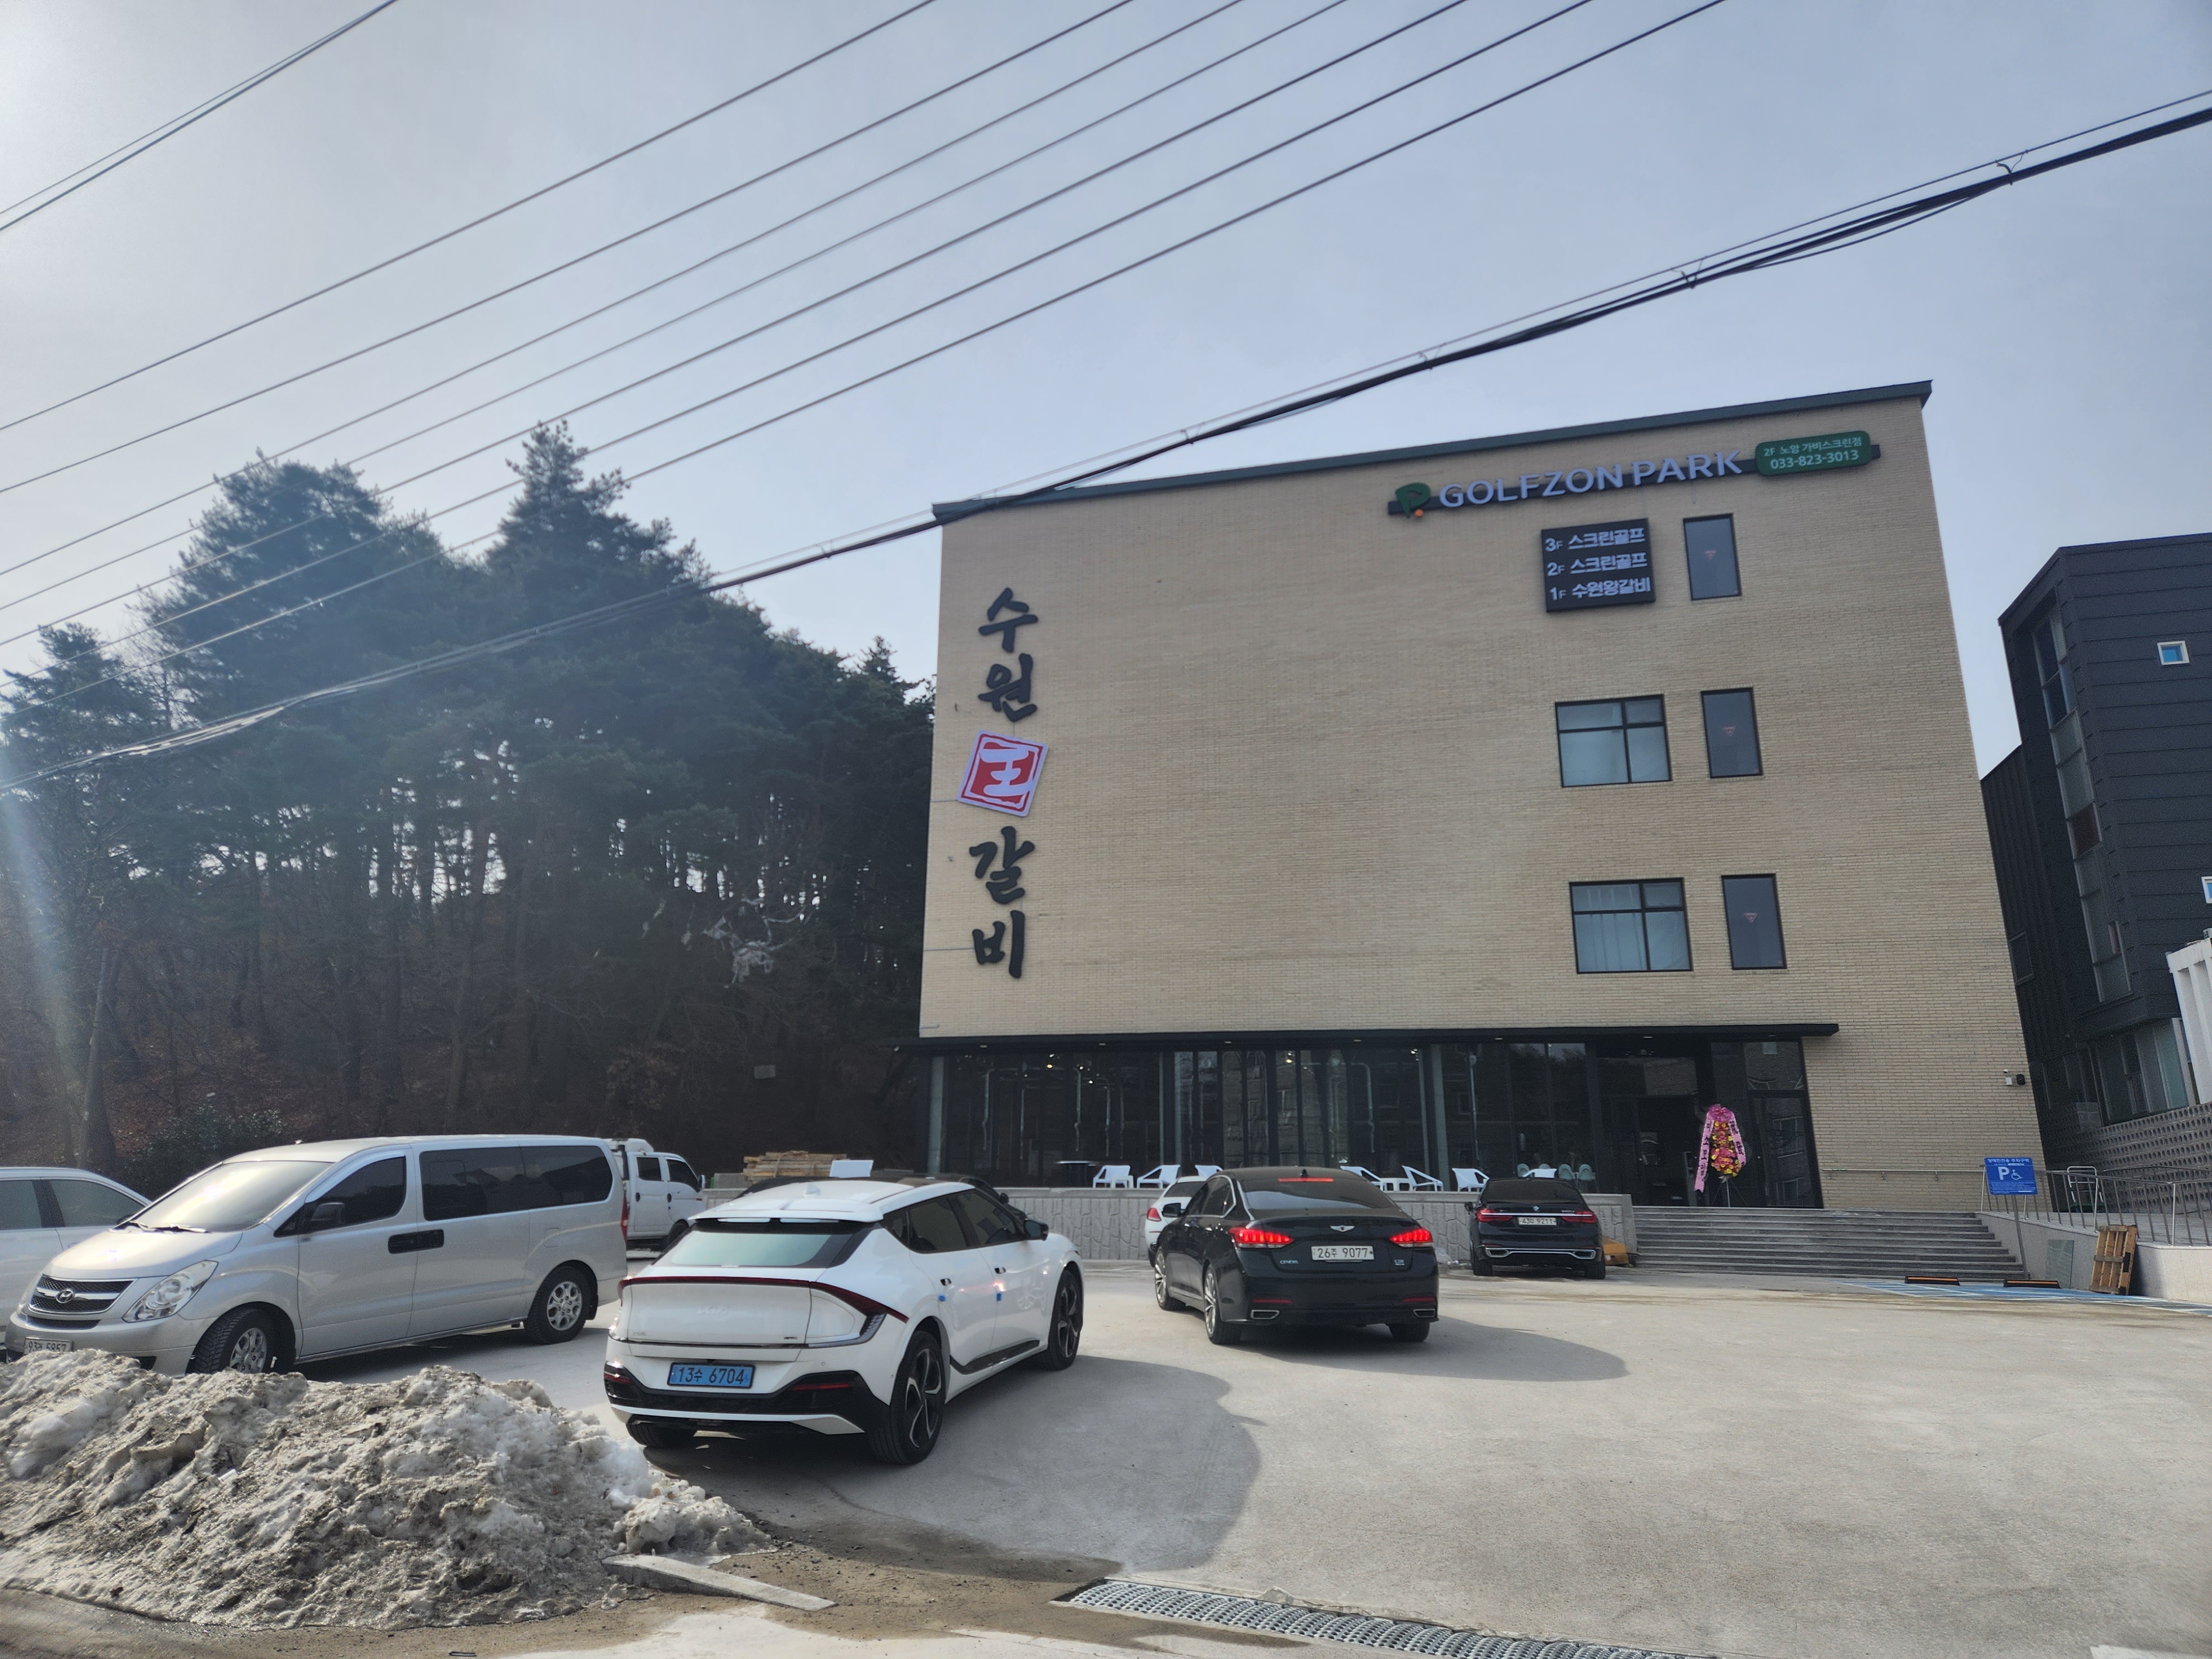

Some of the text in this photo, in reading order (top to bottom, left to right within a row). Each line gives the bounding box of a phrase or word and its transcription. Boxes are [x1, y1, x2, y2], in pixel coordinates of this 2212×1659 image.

[1764, 436, 1862, 457] 2F 노암 가비스크린점
[1771, 450, 1859, 469] 033-823-3013
[1439, 464, 1624, 508] GOLFZON
[1631, 449, 1742, 486] PARK
[1545, 528, 1646, 551] 3F 스크린골프
[1547, 552, 1648, 576] 2F 스크린골프
[1550, 576, 1651, 601] 1F 수원왕갈비
[1997, 1166, 2010, 1180] P
[1317, 1248, 1368, 1258] 26주 9077
[679, 1367, 745, 1384] 13수 6704
